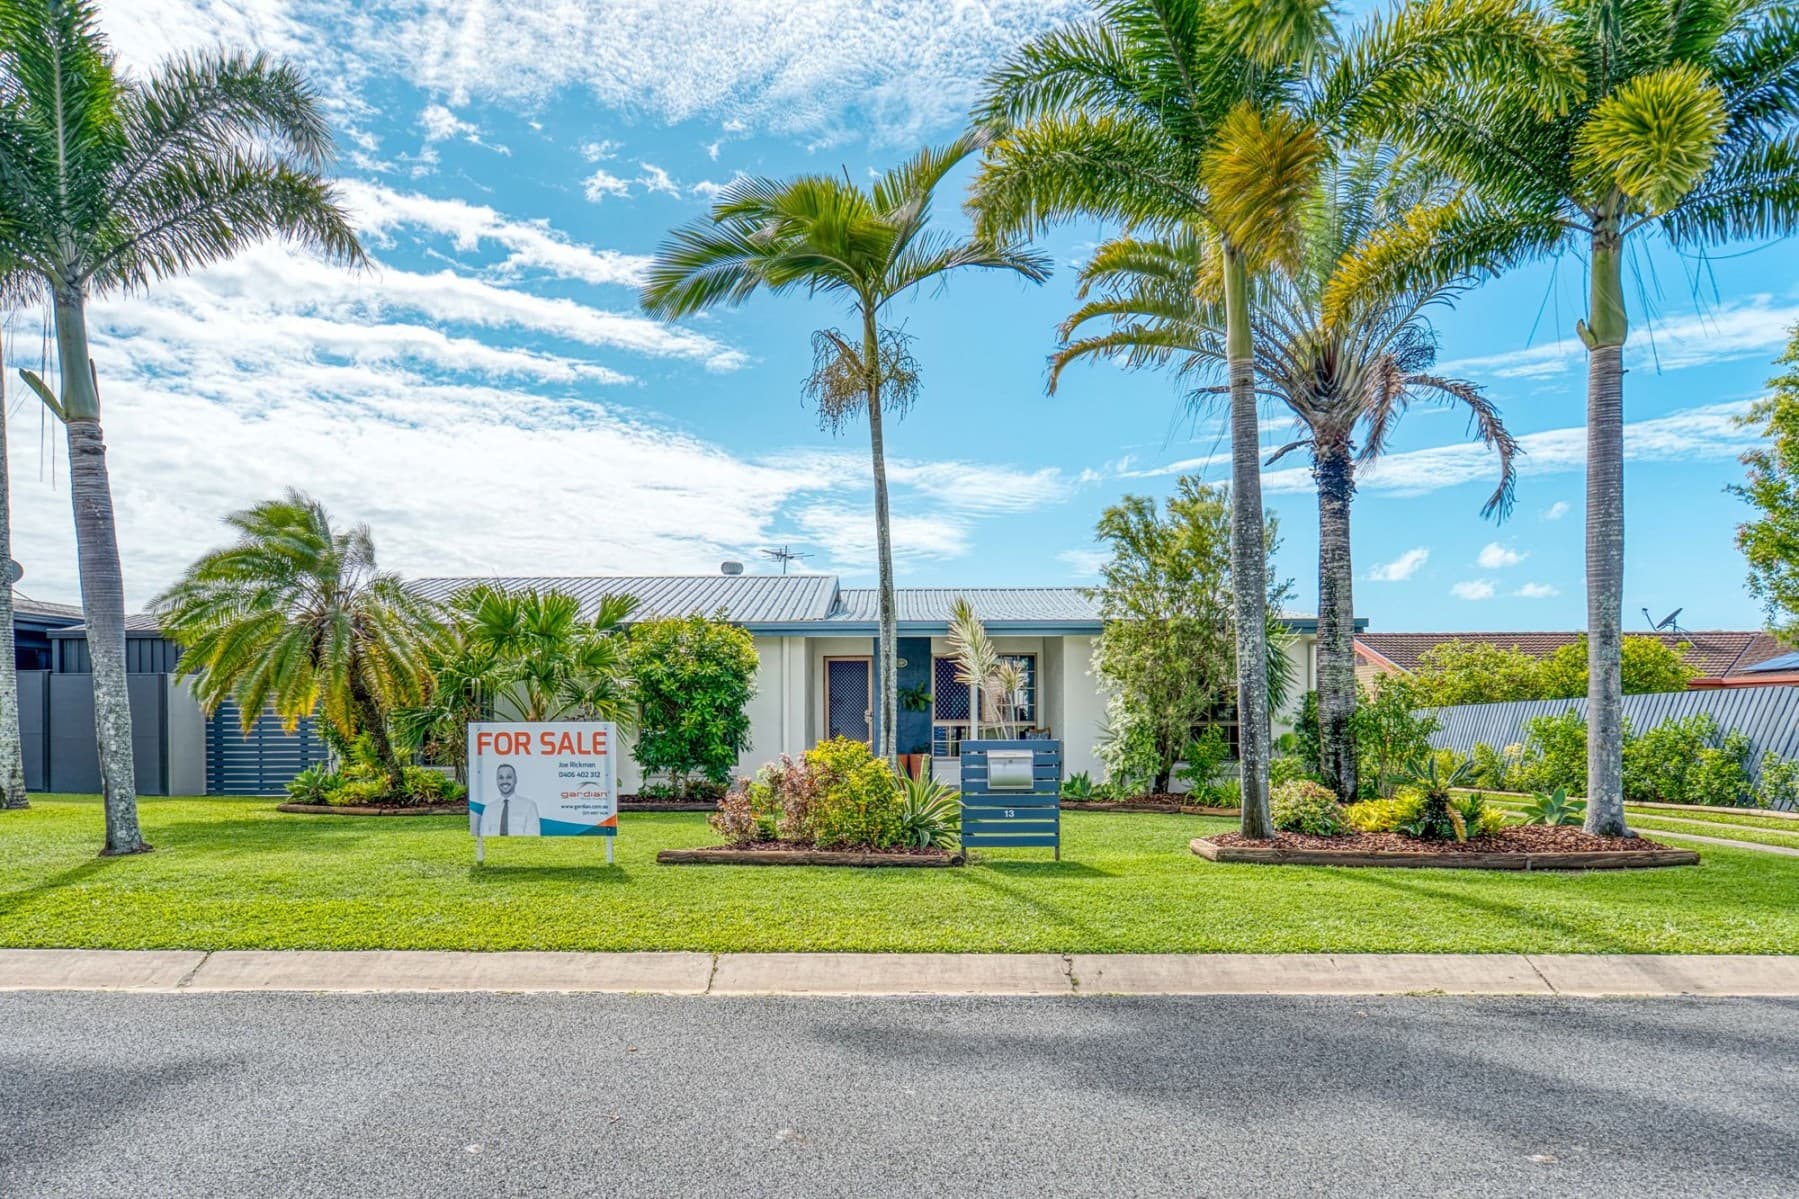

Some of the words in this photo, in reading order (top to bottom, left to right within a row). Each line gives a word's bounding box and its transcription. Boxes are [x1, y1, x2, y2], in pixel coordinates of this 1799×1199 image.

[477, 731, 532, 756] FOR
[540, 731, 608, 756] SALE
[560, 791, 608, 800] gardian
[1004, 810, 1015, 818] 13
